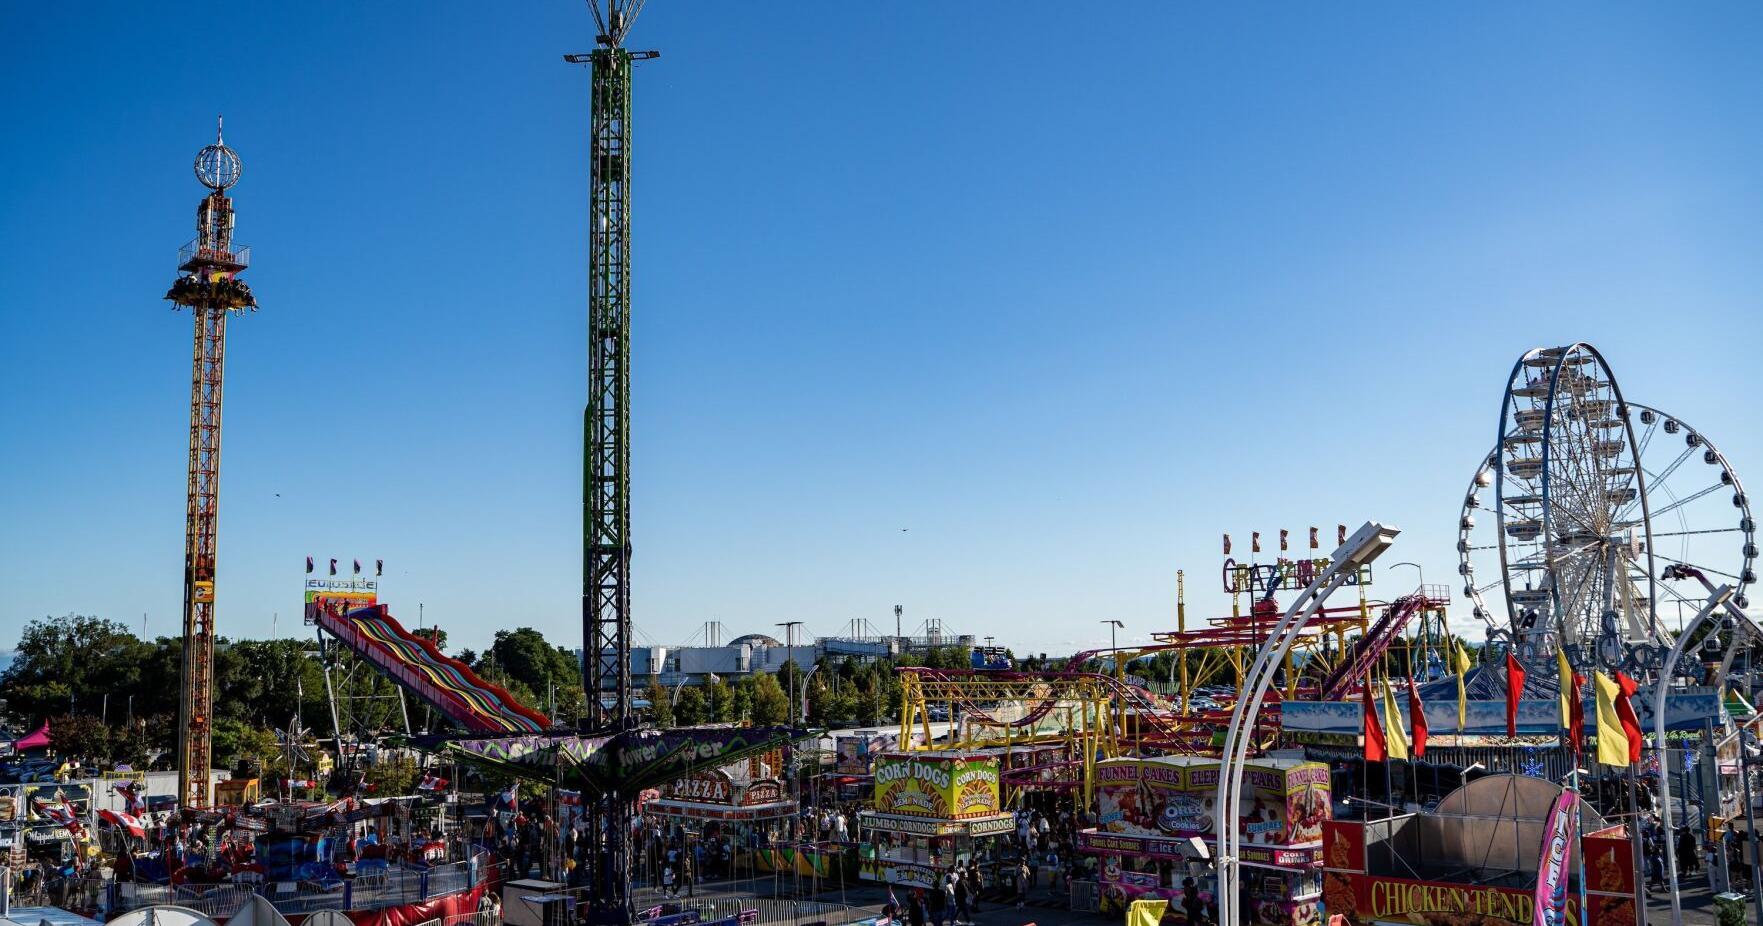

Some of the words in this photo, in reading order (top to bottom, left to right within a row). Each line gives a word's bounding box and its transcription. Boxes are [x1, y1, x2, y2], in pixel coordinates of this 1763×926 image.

[876, 762, 911, 784] CORN
[914, 762, 950, 788] DOGS
[956, 771, 976, 786] CORN
[976, 770, 997, 784] DOGS
[1098, 765, 1139, 781] FUNNEL
[1142, 765, 1180, 785] CAKES
[674, 779, 726, 800] PIZZA
[751, 789, 779, 800] PIZZA
[862, 816, 898, 830] JUMBO
[899, 820, 937, 834] CORNDOGS
[971, 817, 1014, 833] CORNDOGS
[1171, 820, 1200, 830] Cookies
[27, 830, 55, 844] Whipped
[1159, 843, 1175, 854] ICE
[1278, 856, 1310, 864] DRINKS
[1370, 880, 1466, 919] CHICKEN
[1470, 888, 1578, 926] TENDS
